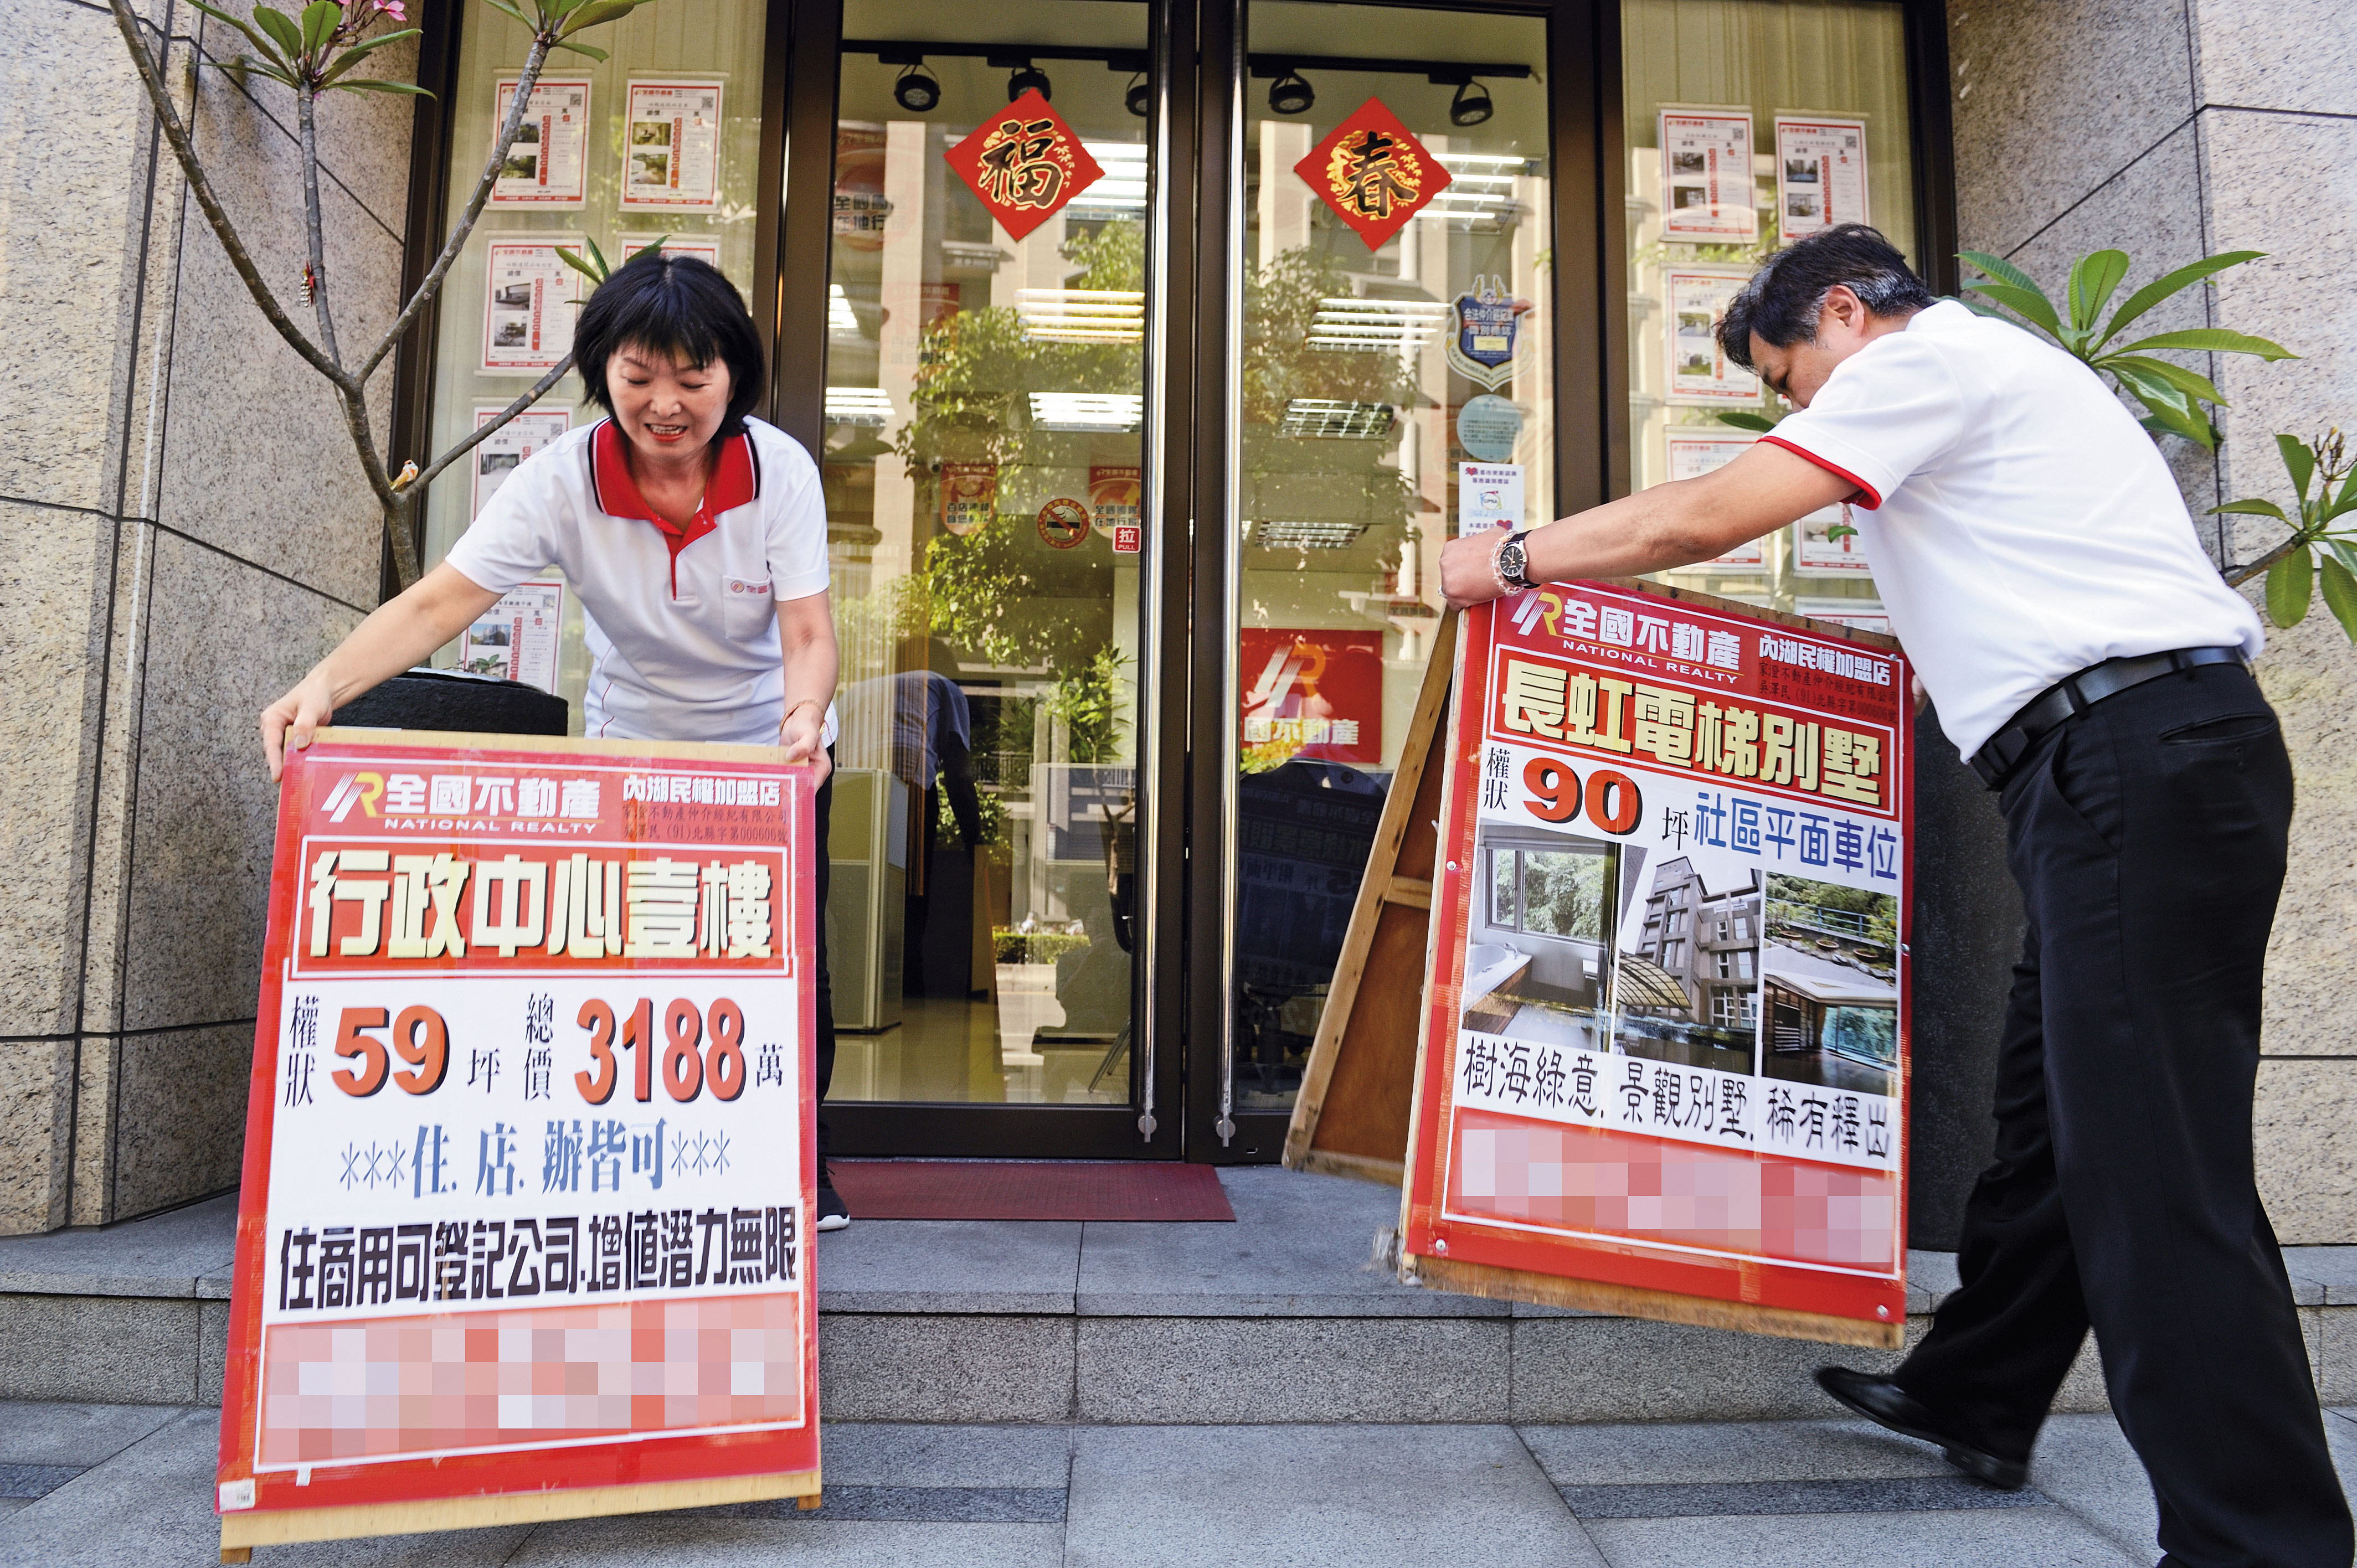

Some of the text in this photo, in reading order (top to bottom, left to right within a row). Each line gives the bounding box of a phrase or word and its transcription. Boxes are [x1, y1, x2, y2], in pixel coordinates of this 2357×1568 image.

[978, 118, 1065, 209] 福
[1340, 131, 1419, 219] 春
[1119, 529, 1135, 543] 拉
[1563, 598, 1741, 671] 全國不動產
[1563, 639, 1738, 684] NATIONAL REALTY
[1759, 634, 1891, 687] 內湖民權加盟店
[1502, 659, 1882, 806] 長虹電梯別墅
[384, 818, 598, 834] NATIONAL REALTY
[385, 773, 600, 819] 全國不動產
[623, 774, 781, 807] 內湖民權加盟店
[1483, 747, 1897, 880] 權狀 90 坪 社區平面車位
[308, 849, 774, 958] 行政中心壹樓
[284, 992, 784, 1108] 權狀 59 坪 總價 3188 萬
